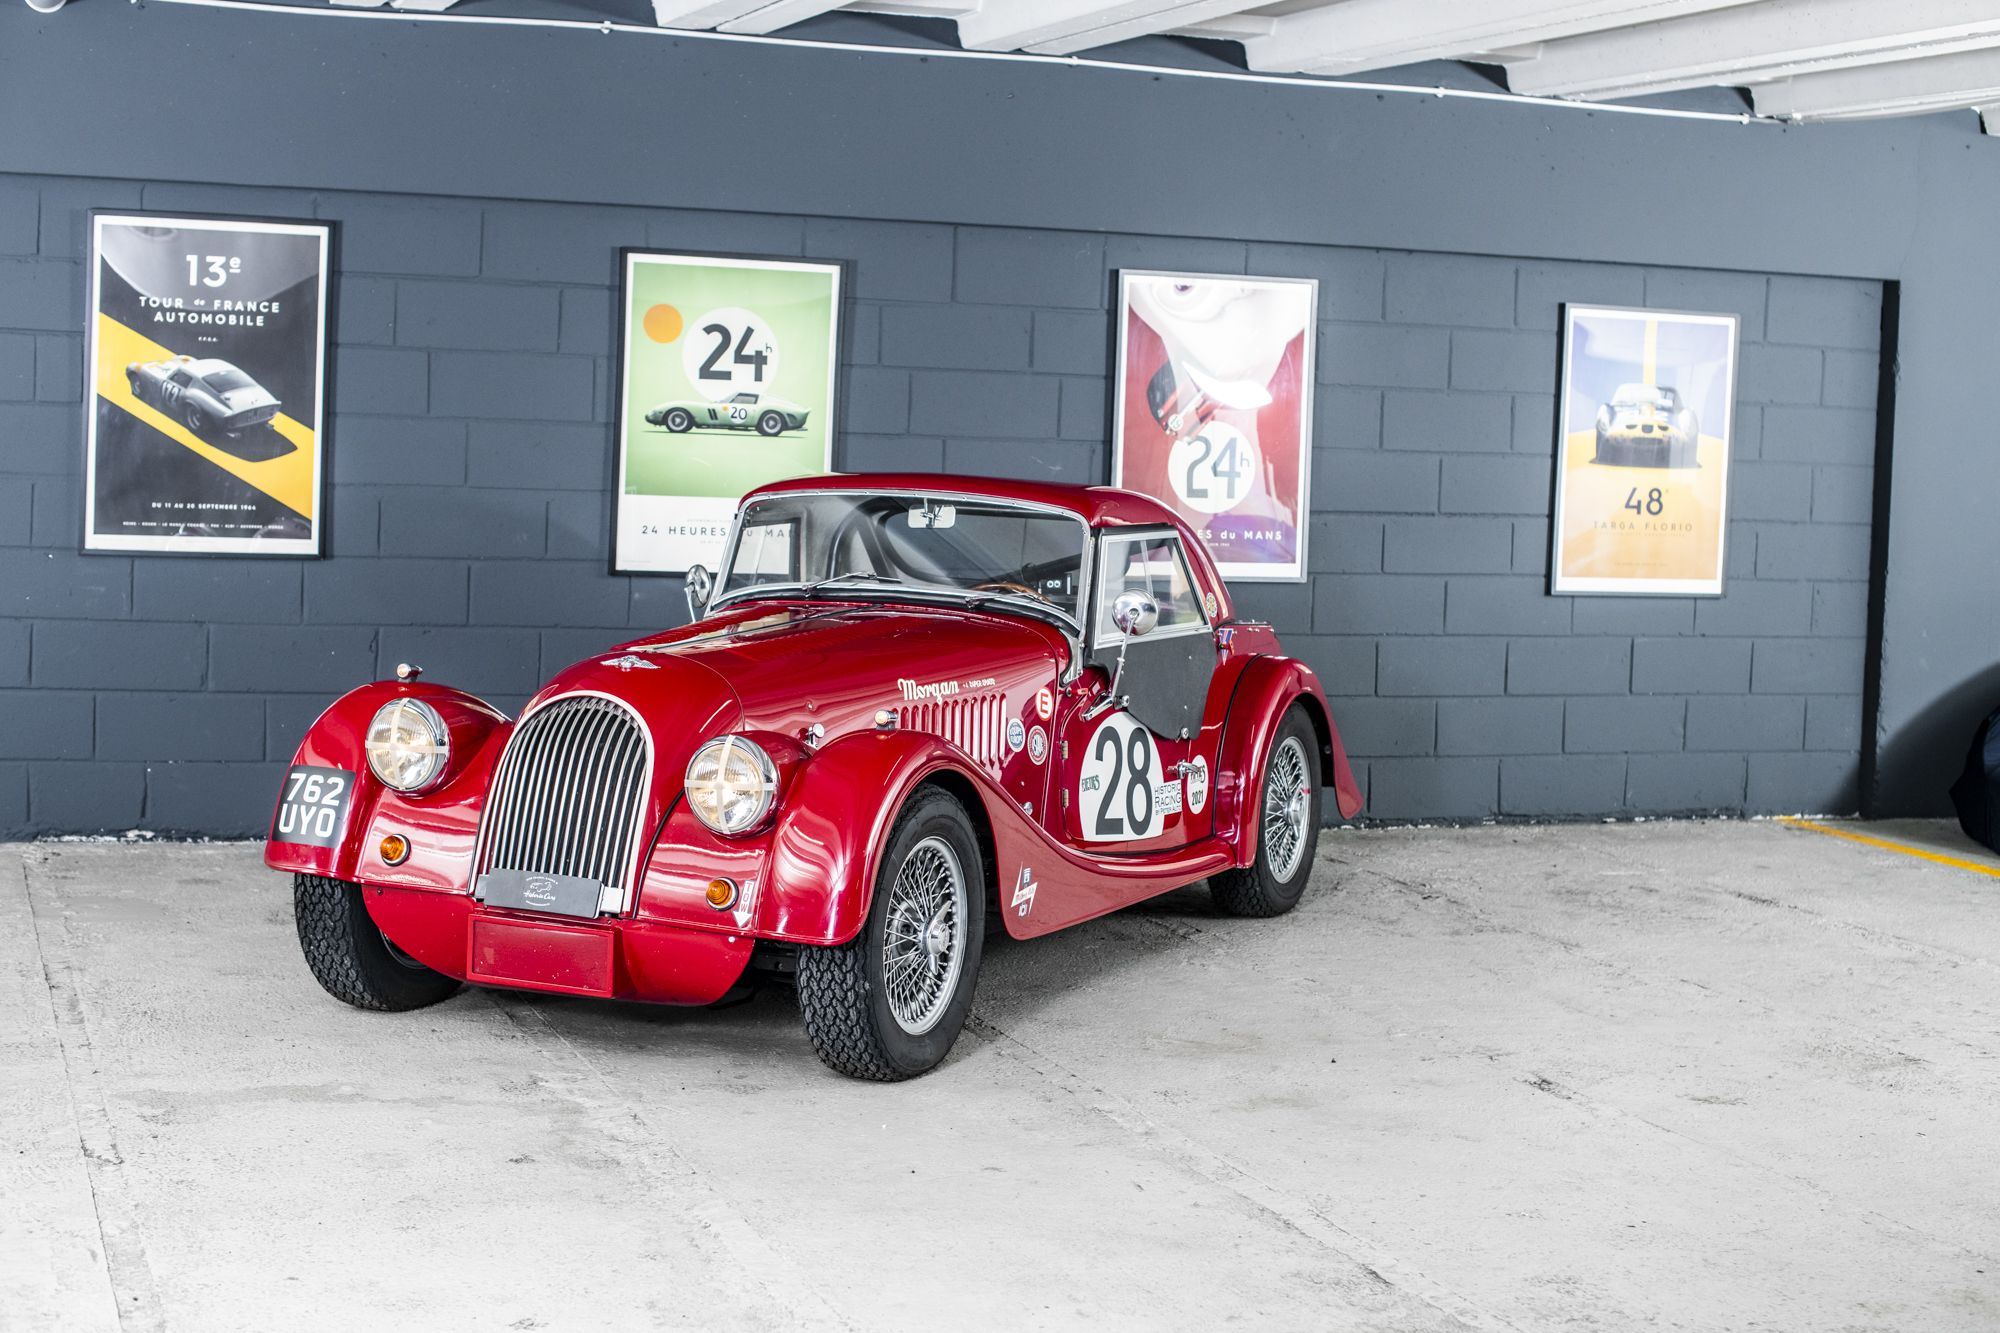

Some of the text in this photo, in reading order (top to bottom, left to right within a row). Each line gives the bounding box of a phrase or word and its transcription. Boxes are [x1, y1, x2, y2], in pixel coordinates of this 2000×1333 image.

[139, 296, 280, 313] TOUR de FRANCE
[154, 311, 265, 327] AUTOMOBILE
[731, 406, 747, 420] 20
[641, 525, 659, 535] 24
[668, 526, 727, 537] HEURES
[1593, 520, 1694, 532] TARGA FLORIO
[1220, 529, 1236, 540] du
[1244, 530, 1283, 541] MANS
[898, 678, 960, 704] Morgan
[1040, 693, 1049, 715] E
[1095, 726, 1153, 836] 28
[287, 773, 345, 807] 762
[1154, 782, 1181, 797] HISTORIC
[1155, 792, 1182, 808] RACING
[1191, 790, 1204, 806] 2021
